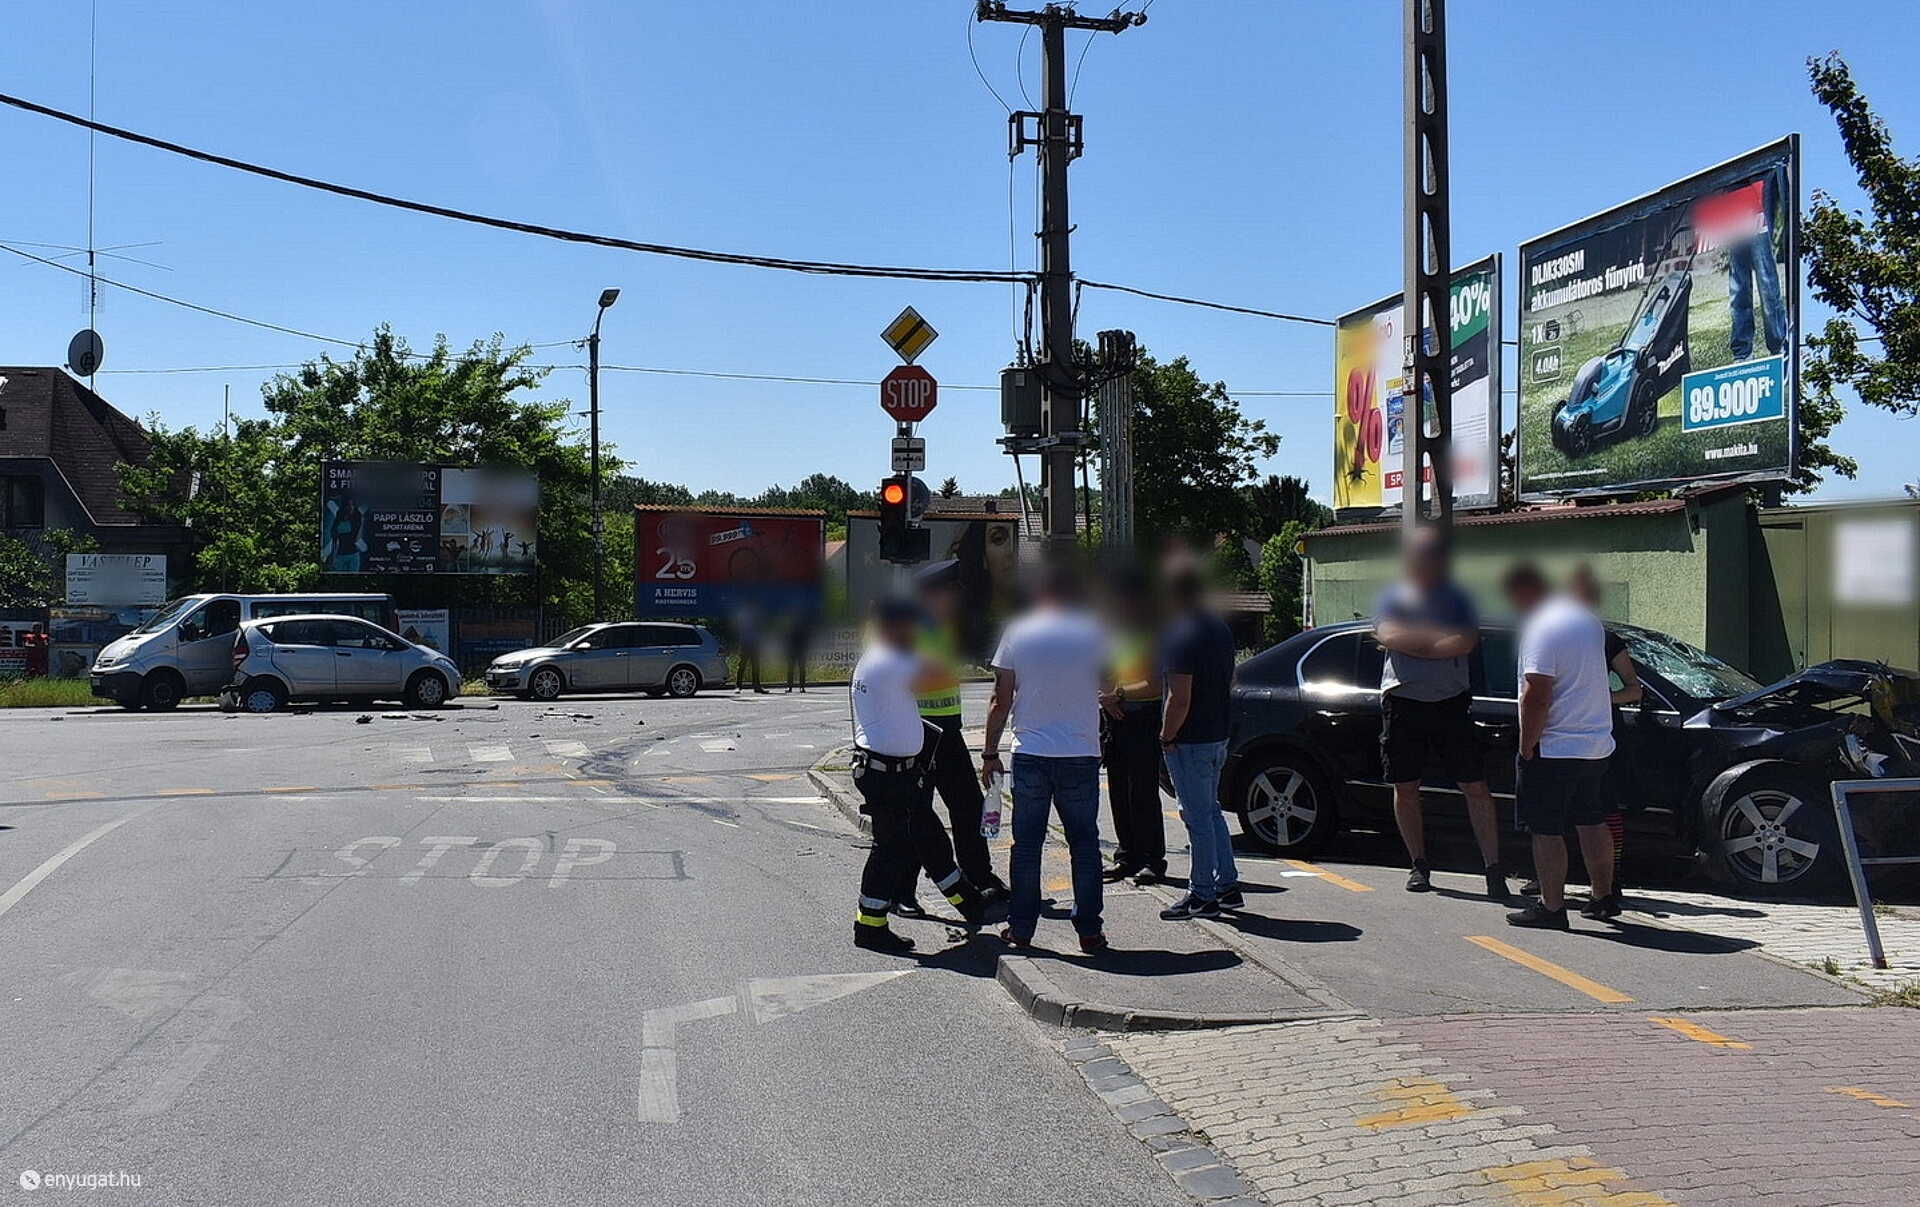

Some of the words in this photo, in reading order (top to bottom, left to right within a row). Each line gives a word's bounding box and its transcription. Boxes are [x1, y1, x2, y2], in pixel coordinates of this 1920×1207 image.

[1532, 250, 1585, 287] DLM330SM
[1531, 274, 1603, 312] akkumulátoros
[887, 379, 931, 409] STOP
[1704, 442, 1758, 460] www.makita.hu
[373, 513, 397, 522] PAPP
[399, 511, 434, 523] LÁSZLÓ
[655, 546, 697, 579] 25
[664, 588, 697, 597] HERVIS
[311, 835, 617, 889] STOP
